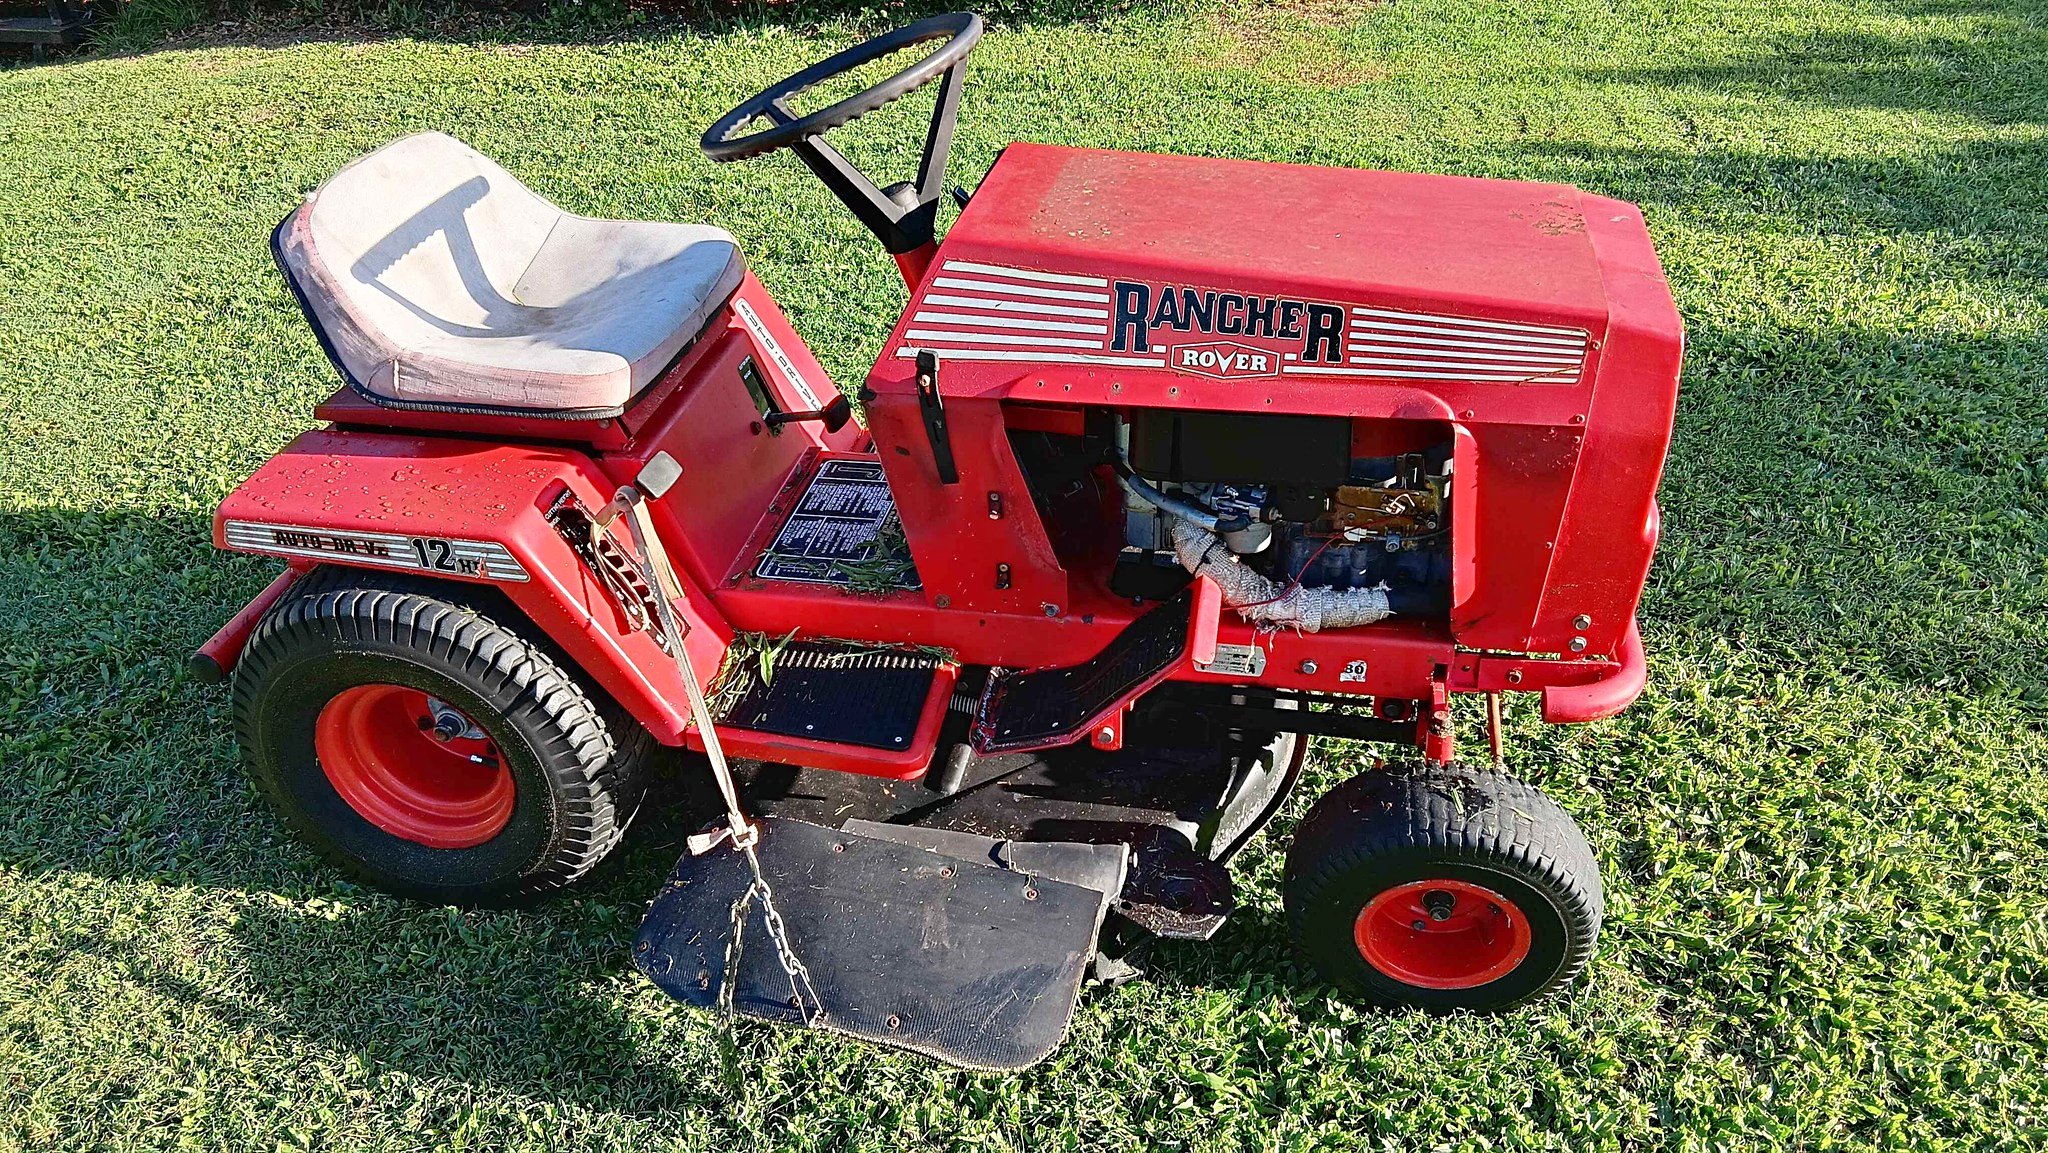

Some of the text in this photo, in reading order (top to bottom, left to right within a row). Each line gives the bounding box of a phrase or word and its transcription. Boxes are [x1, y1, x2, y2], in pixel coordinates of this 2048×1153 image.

[1110, 281, 1346, 363] RANCHER
[1181, 345, 1267, 375] ROVER
[274, 530, 322, 549] AUTO
[410, 538, 457, 572] 12
